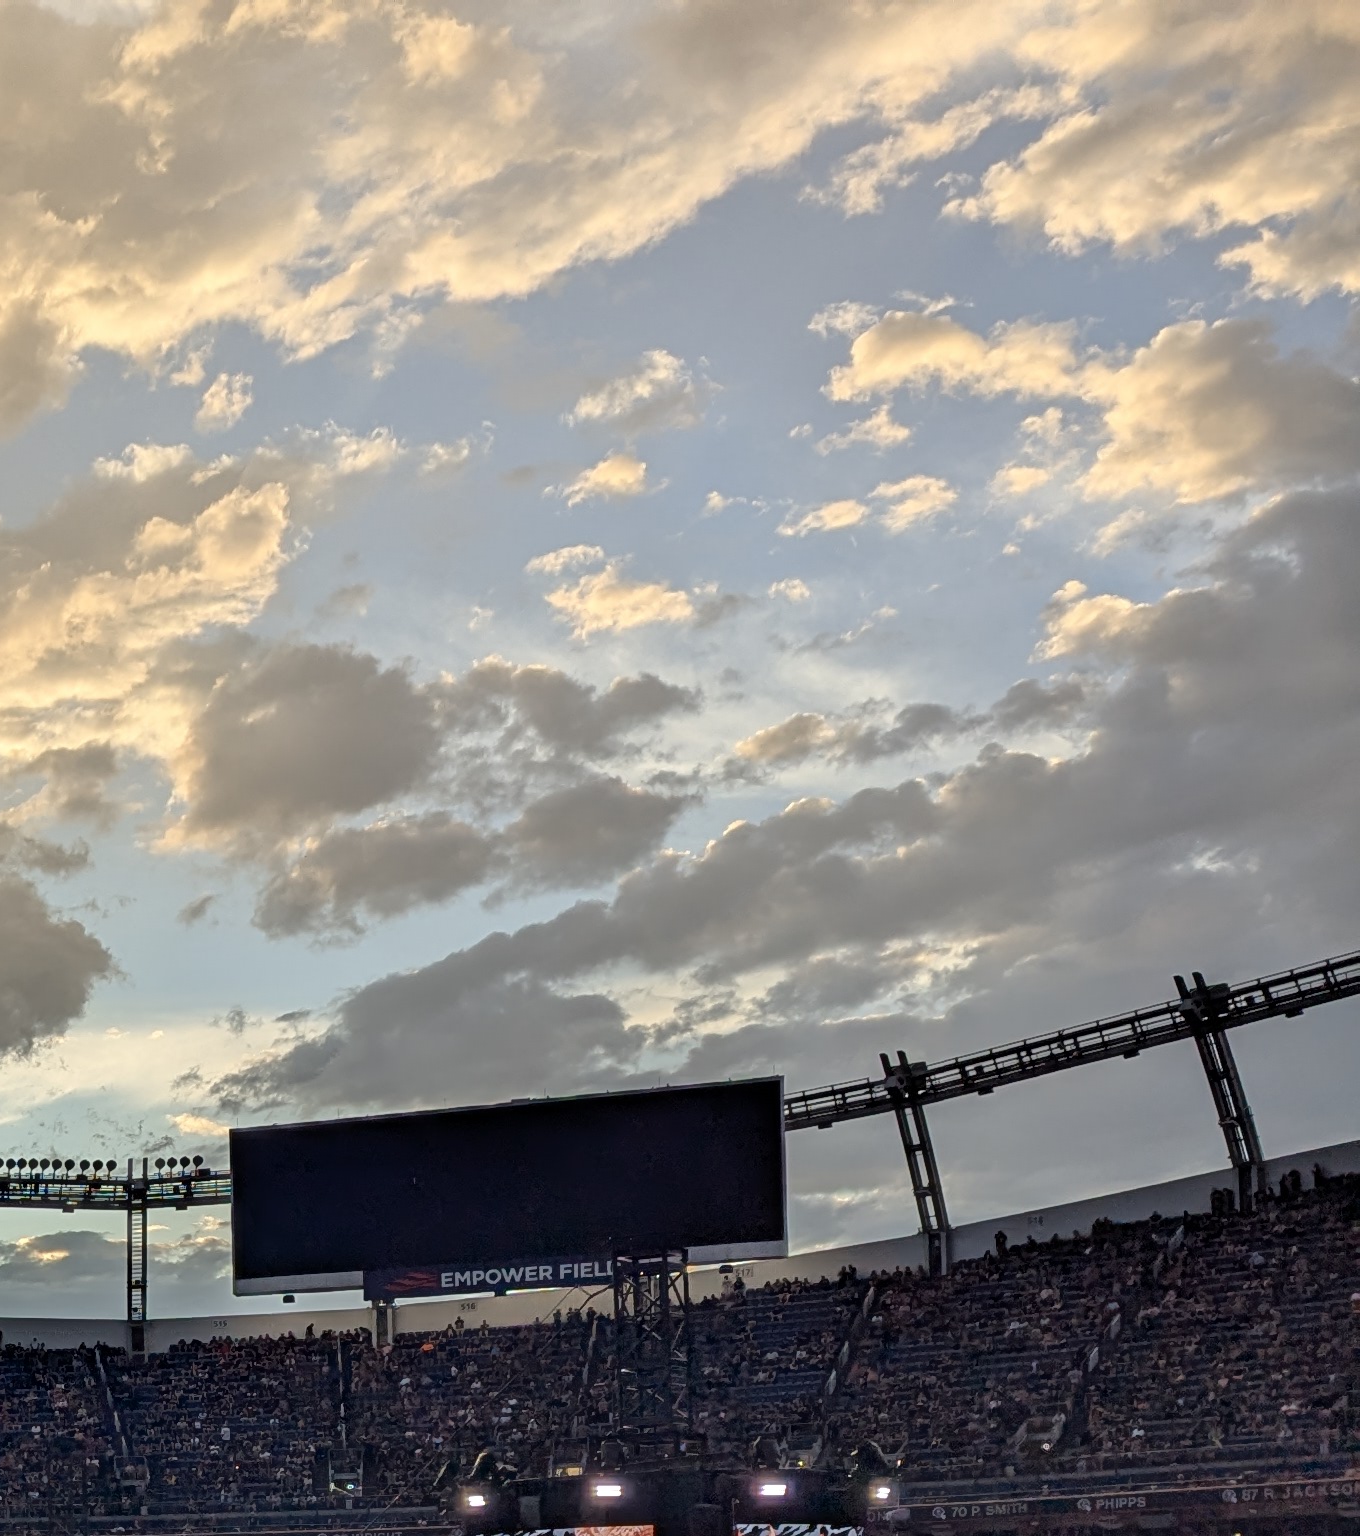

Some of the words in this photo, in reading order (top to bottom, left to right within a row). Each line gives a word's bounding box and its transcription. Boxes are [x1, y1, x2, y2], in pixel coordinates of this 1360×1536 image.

[441, 1265, 552, 1288] EMPOWER
[1241, 1489, 1259, 1501] 87
[952, 1507, 967, 1517] 70
[985, 1502, 1028, 1515] SMITH
[1096, 1497, 1146, 1509] PHIPPS
